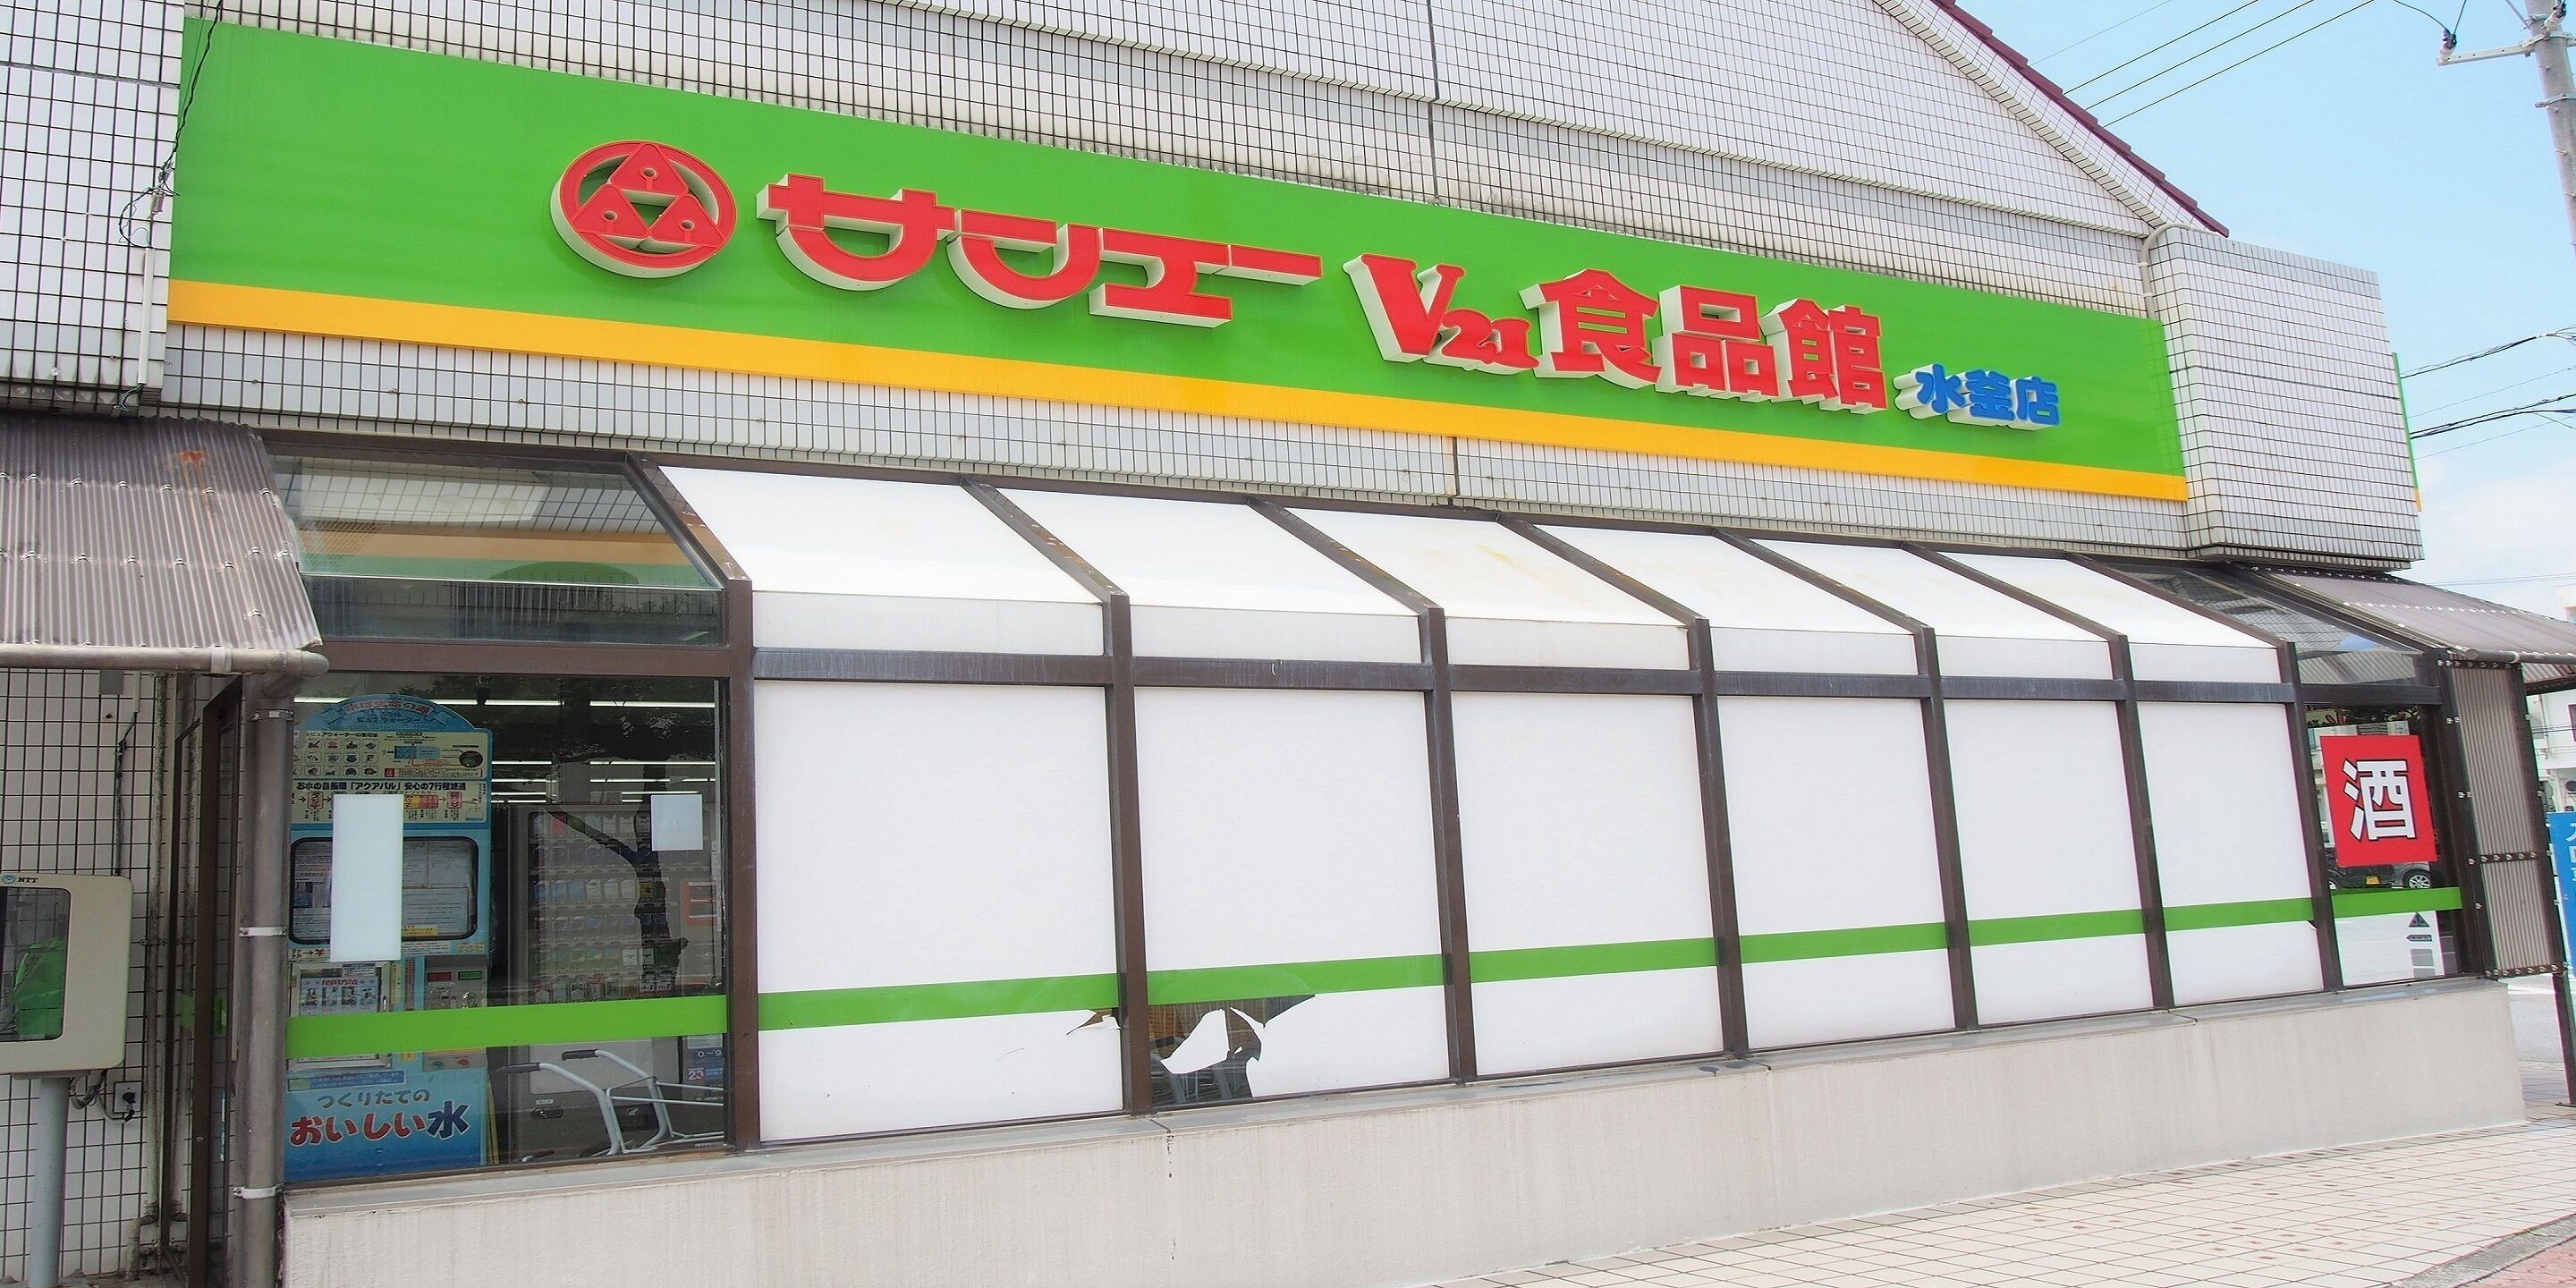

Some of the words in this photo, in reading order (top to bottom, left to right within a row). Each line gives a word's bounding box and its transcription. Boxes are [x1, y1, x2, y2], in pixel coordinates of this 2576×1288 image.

[767, 173, 1323, 322] サンエー
[1914, 362, 2060, 426] 水釜店
[2343, 758, 2416, 841] 酒
[290, 1100, 470, 1146] おいしい水
[317, 1089, 430, 1109] つくりたての
